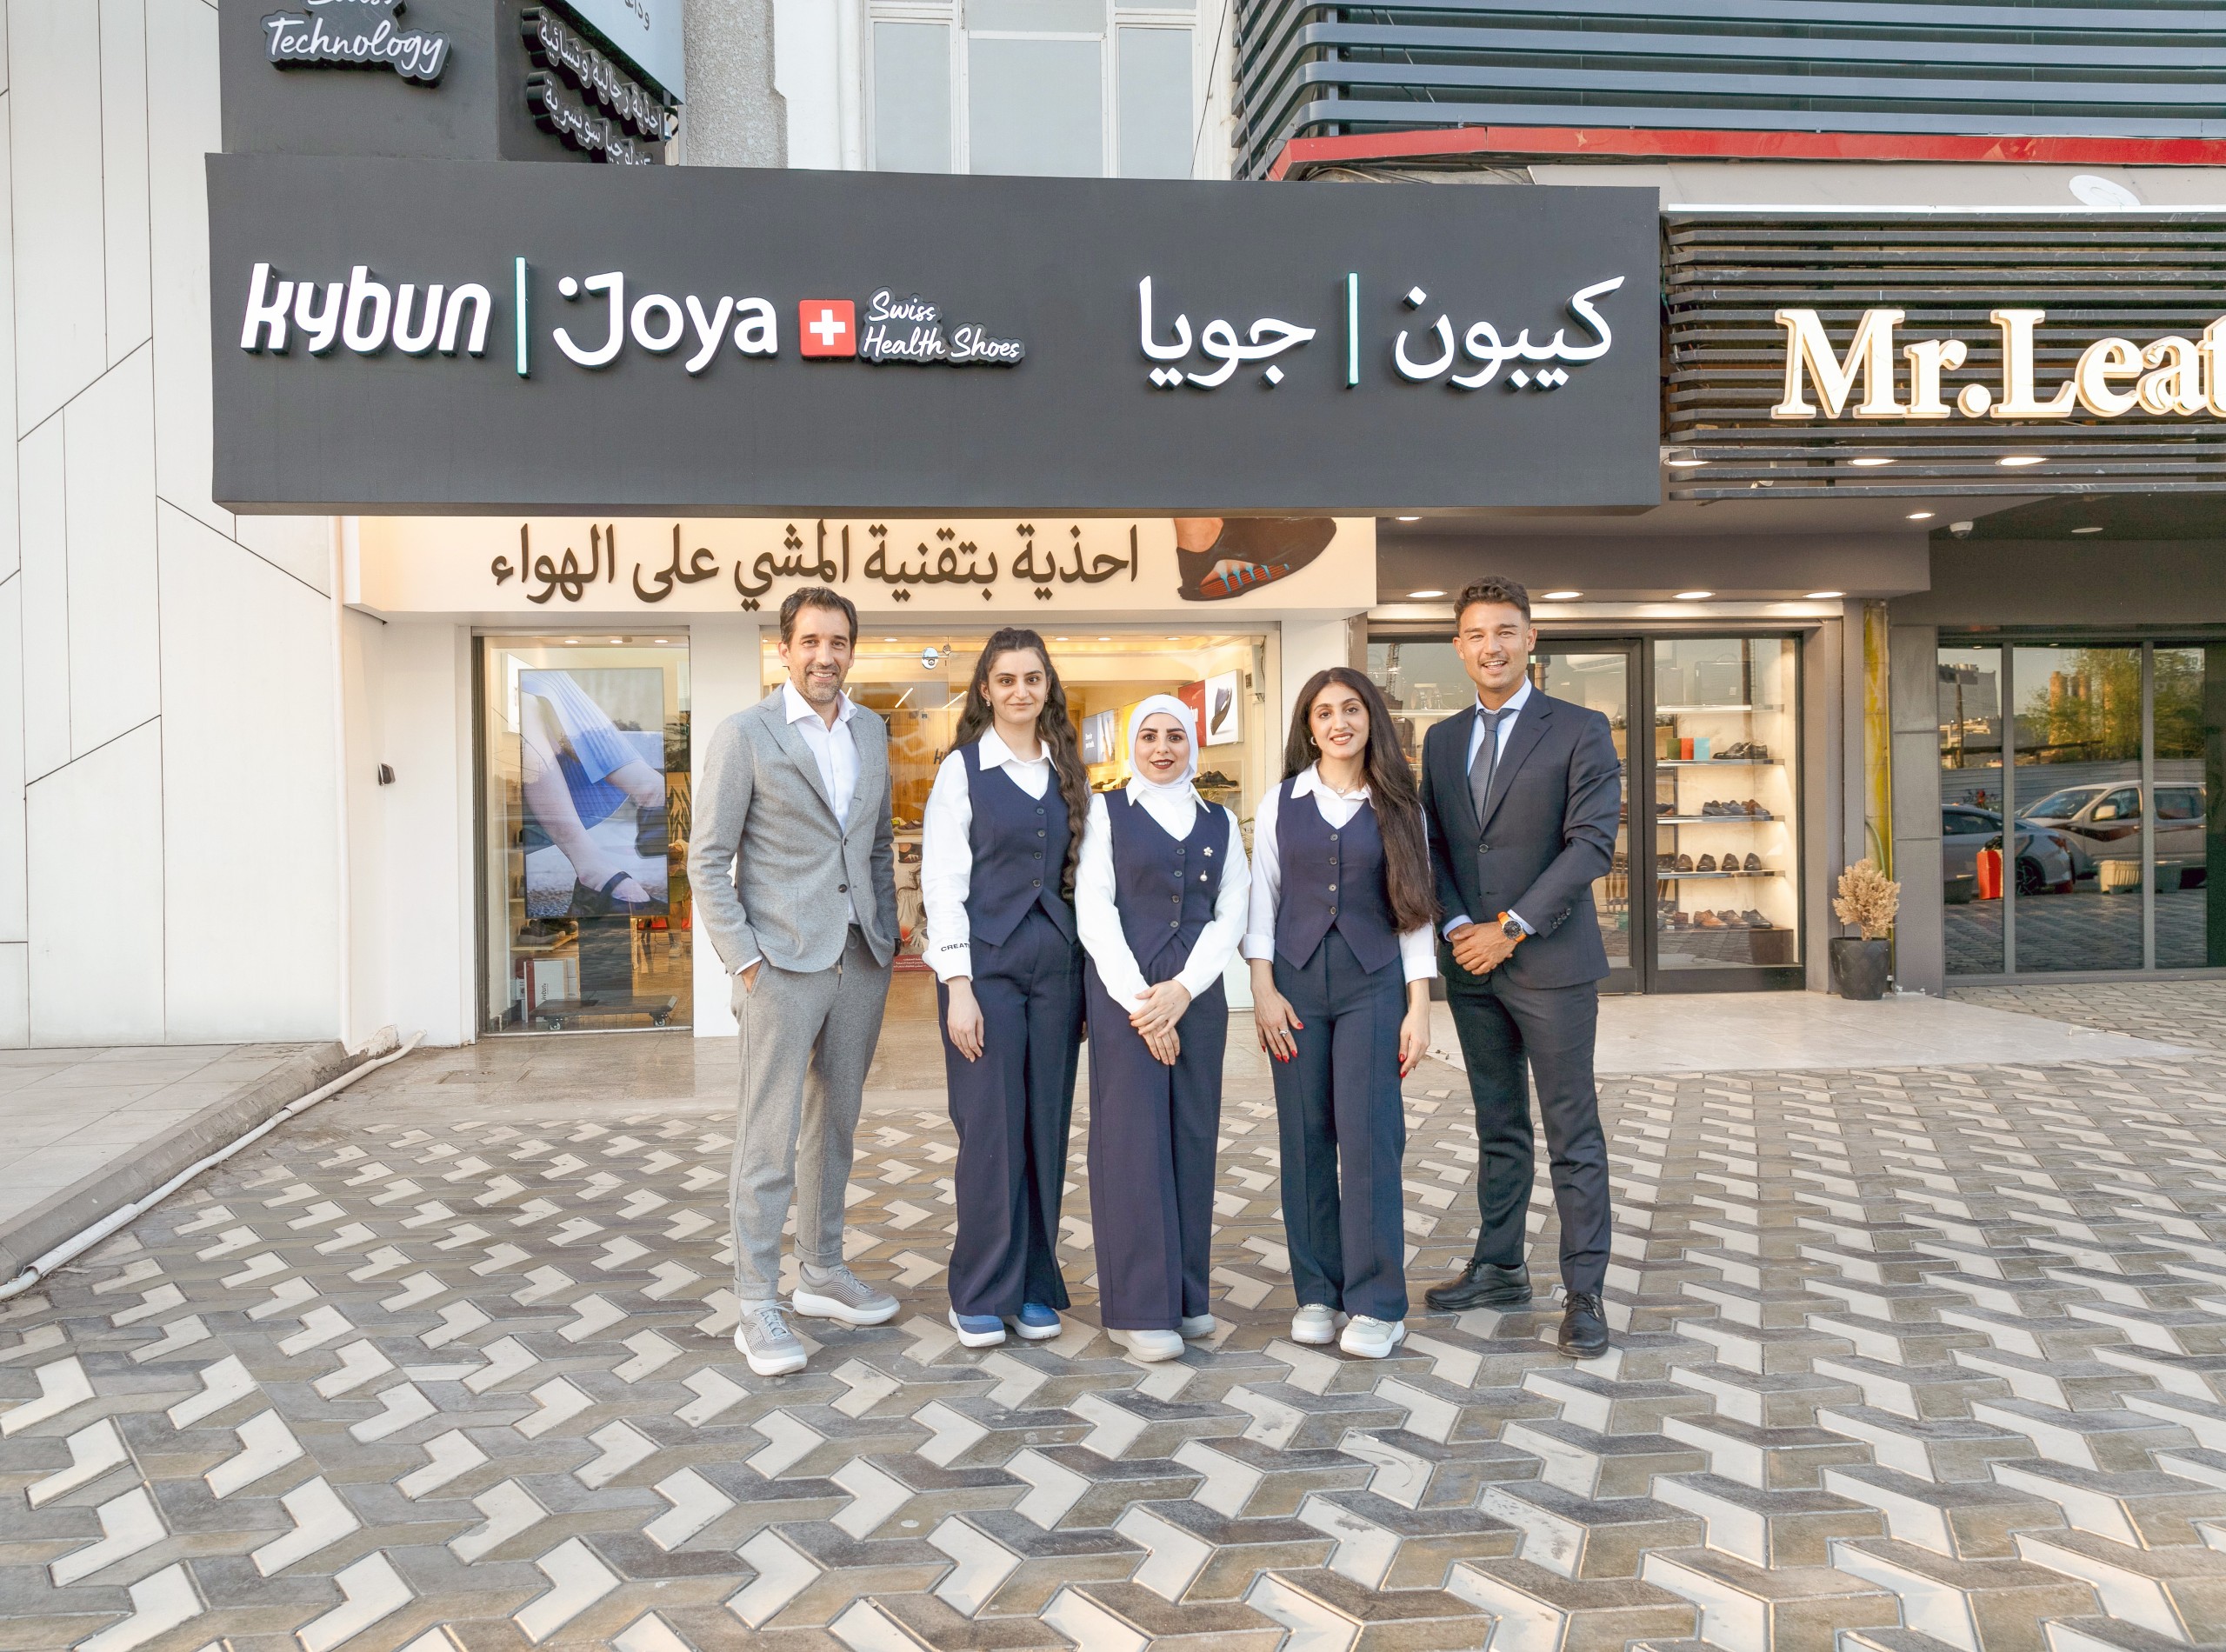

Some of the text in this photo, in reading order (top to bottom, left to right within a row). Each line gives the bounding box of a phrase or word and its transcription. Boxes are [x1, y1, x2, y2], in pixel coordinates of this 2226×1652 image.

[267, 17, 443, 74] Technology
[540, 14, 663, 135] احذية رجالية ونسائية
[545, 79, 601, 143] سويسرية
[240, 263, 779, 376] kybun Joya
[863, 324, 1021, 360] Health Shoes
[867, 290, 937, 323] Swiss
[1138, 275, 1625, 391] كيبون جويا
[490, 519, 1138, 612] احذية بتقنية المشي على الهواء
